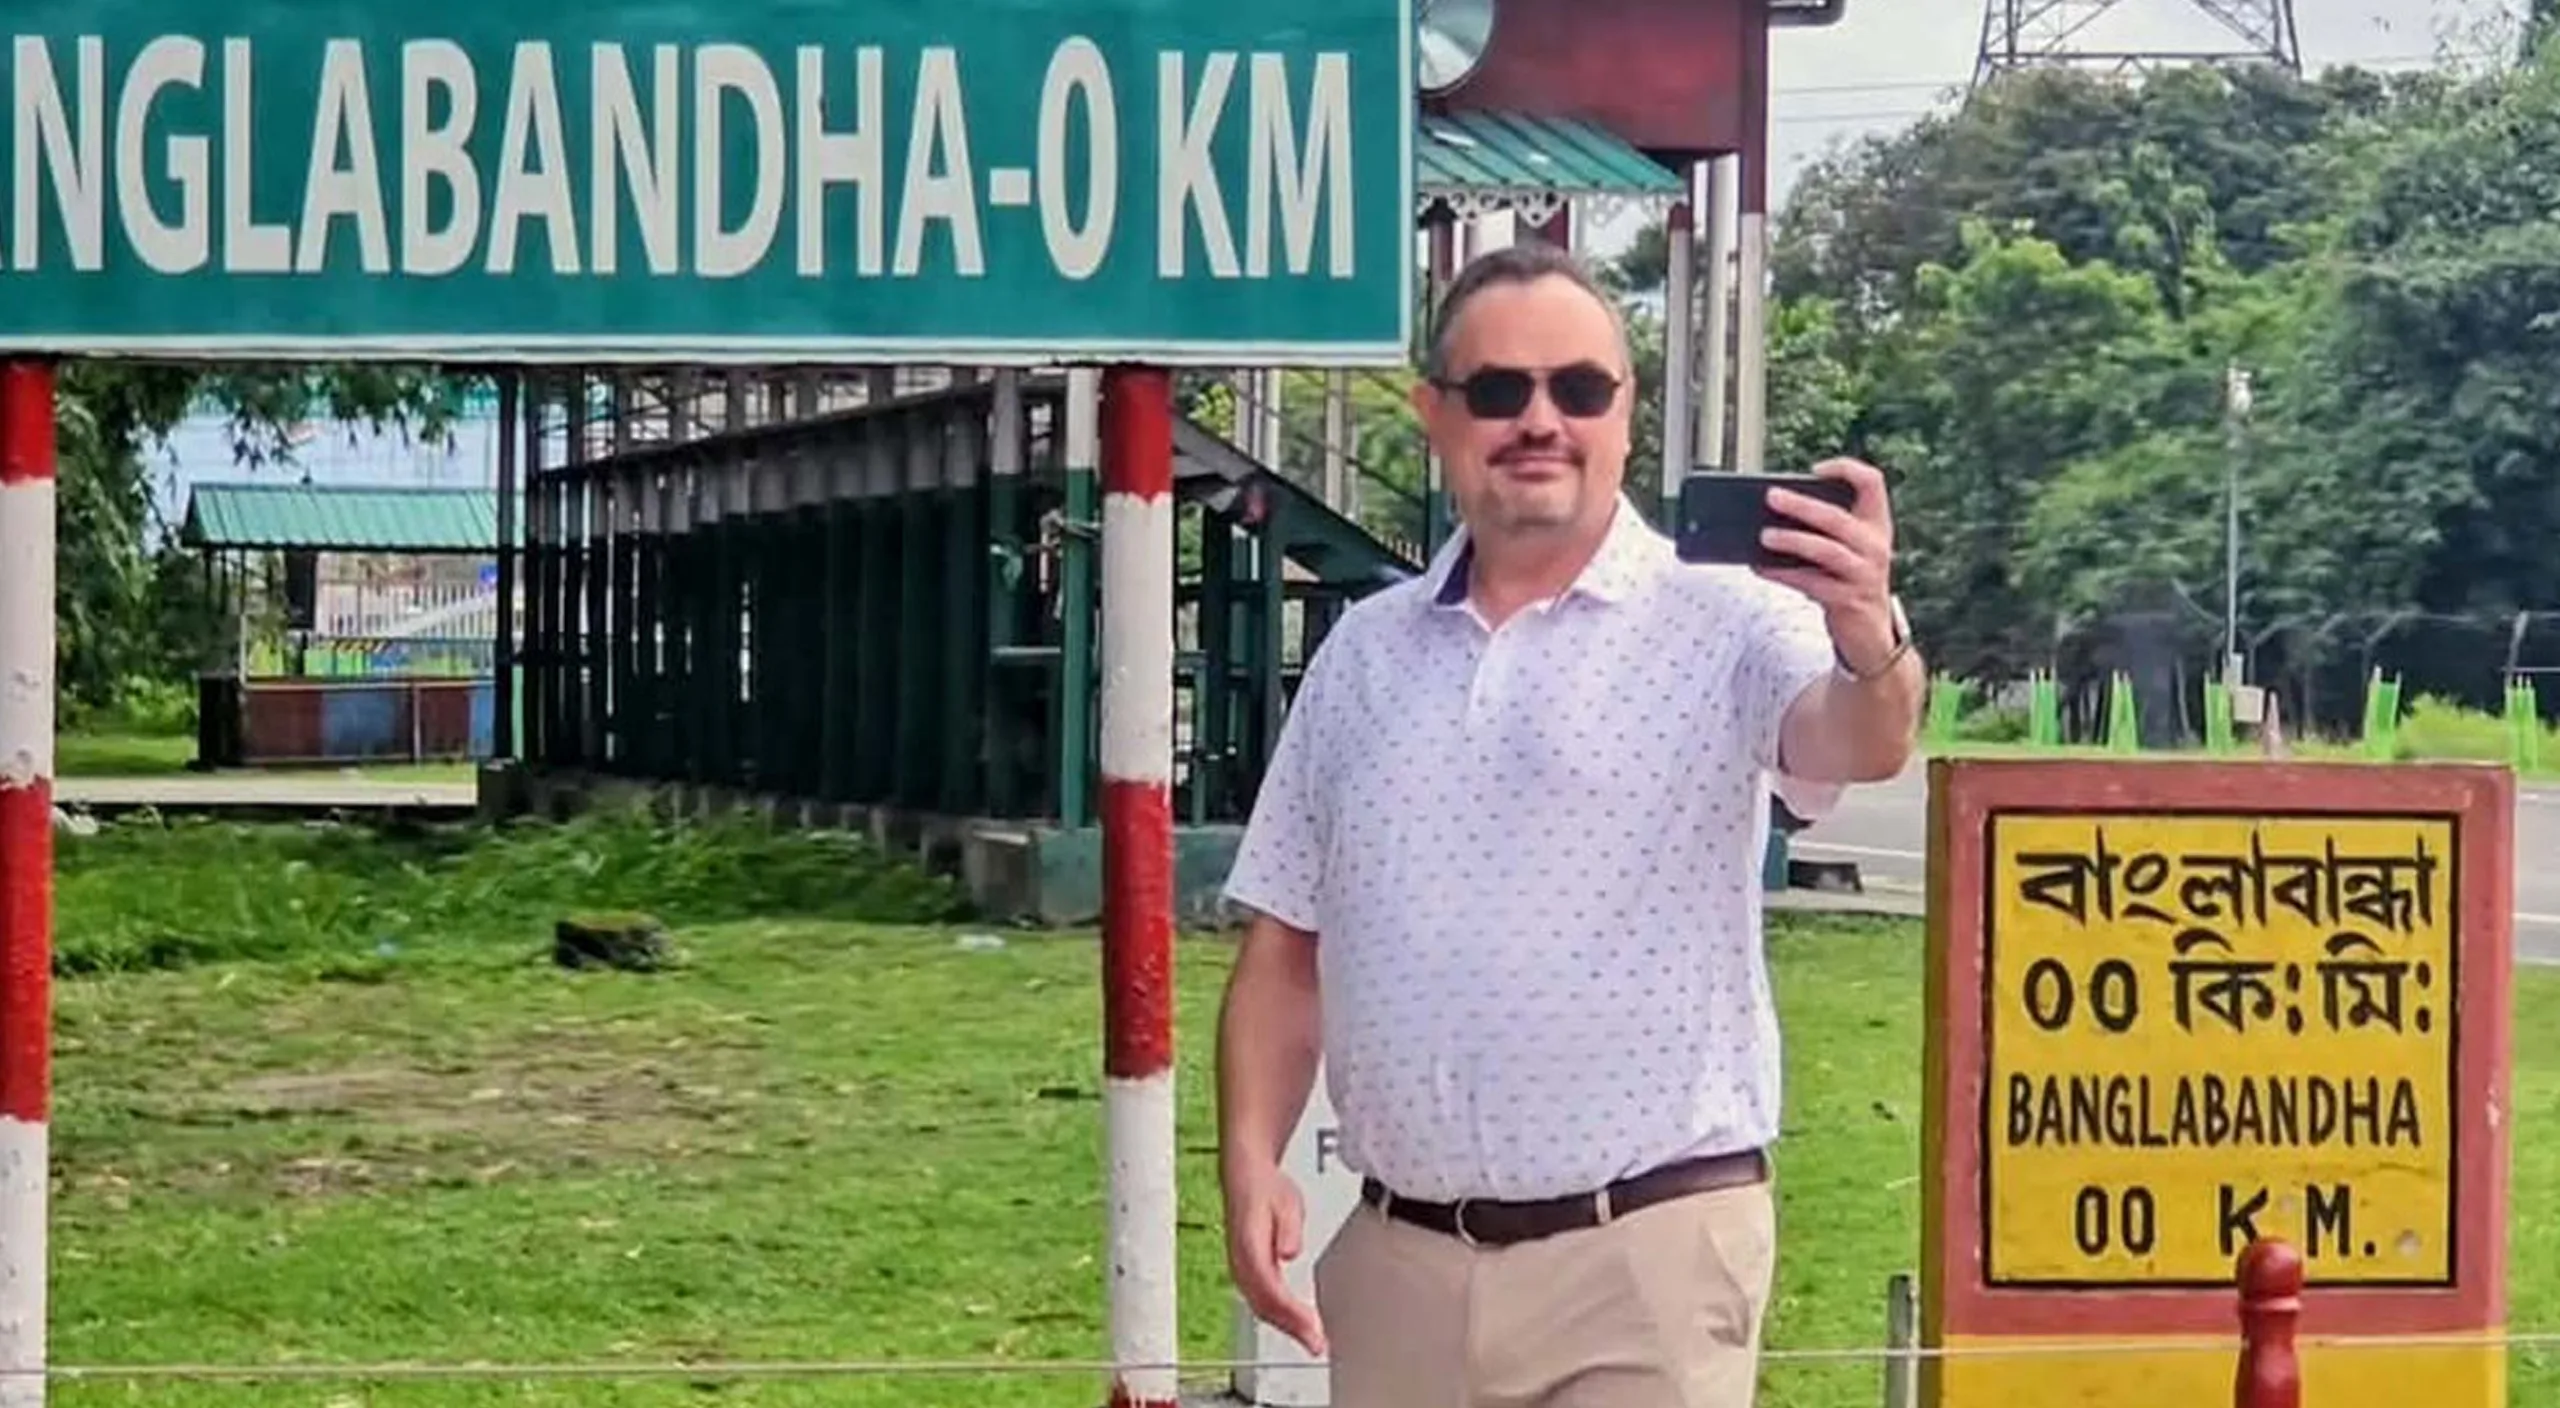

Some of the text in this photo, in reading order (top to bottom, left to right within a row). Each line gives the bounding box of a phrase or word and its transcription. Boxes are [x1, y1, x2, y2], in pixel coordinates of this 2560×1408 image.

[0, 35, 1354, 279] NGLABANDHA-0 KM
[2016, 826, 2437, 934] বাংলাবান্ধা
[2008, 1073, 2421, 1147] BANGLABANDHA
[2075, 1187, 2155, 1256] 00
